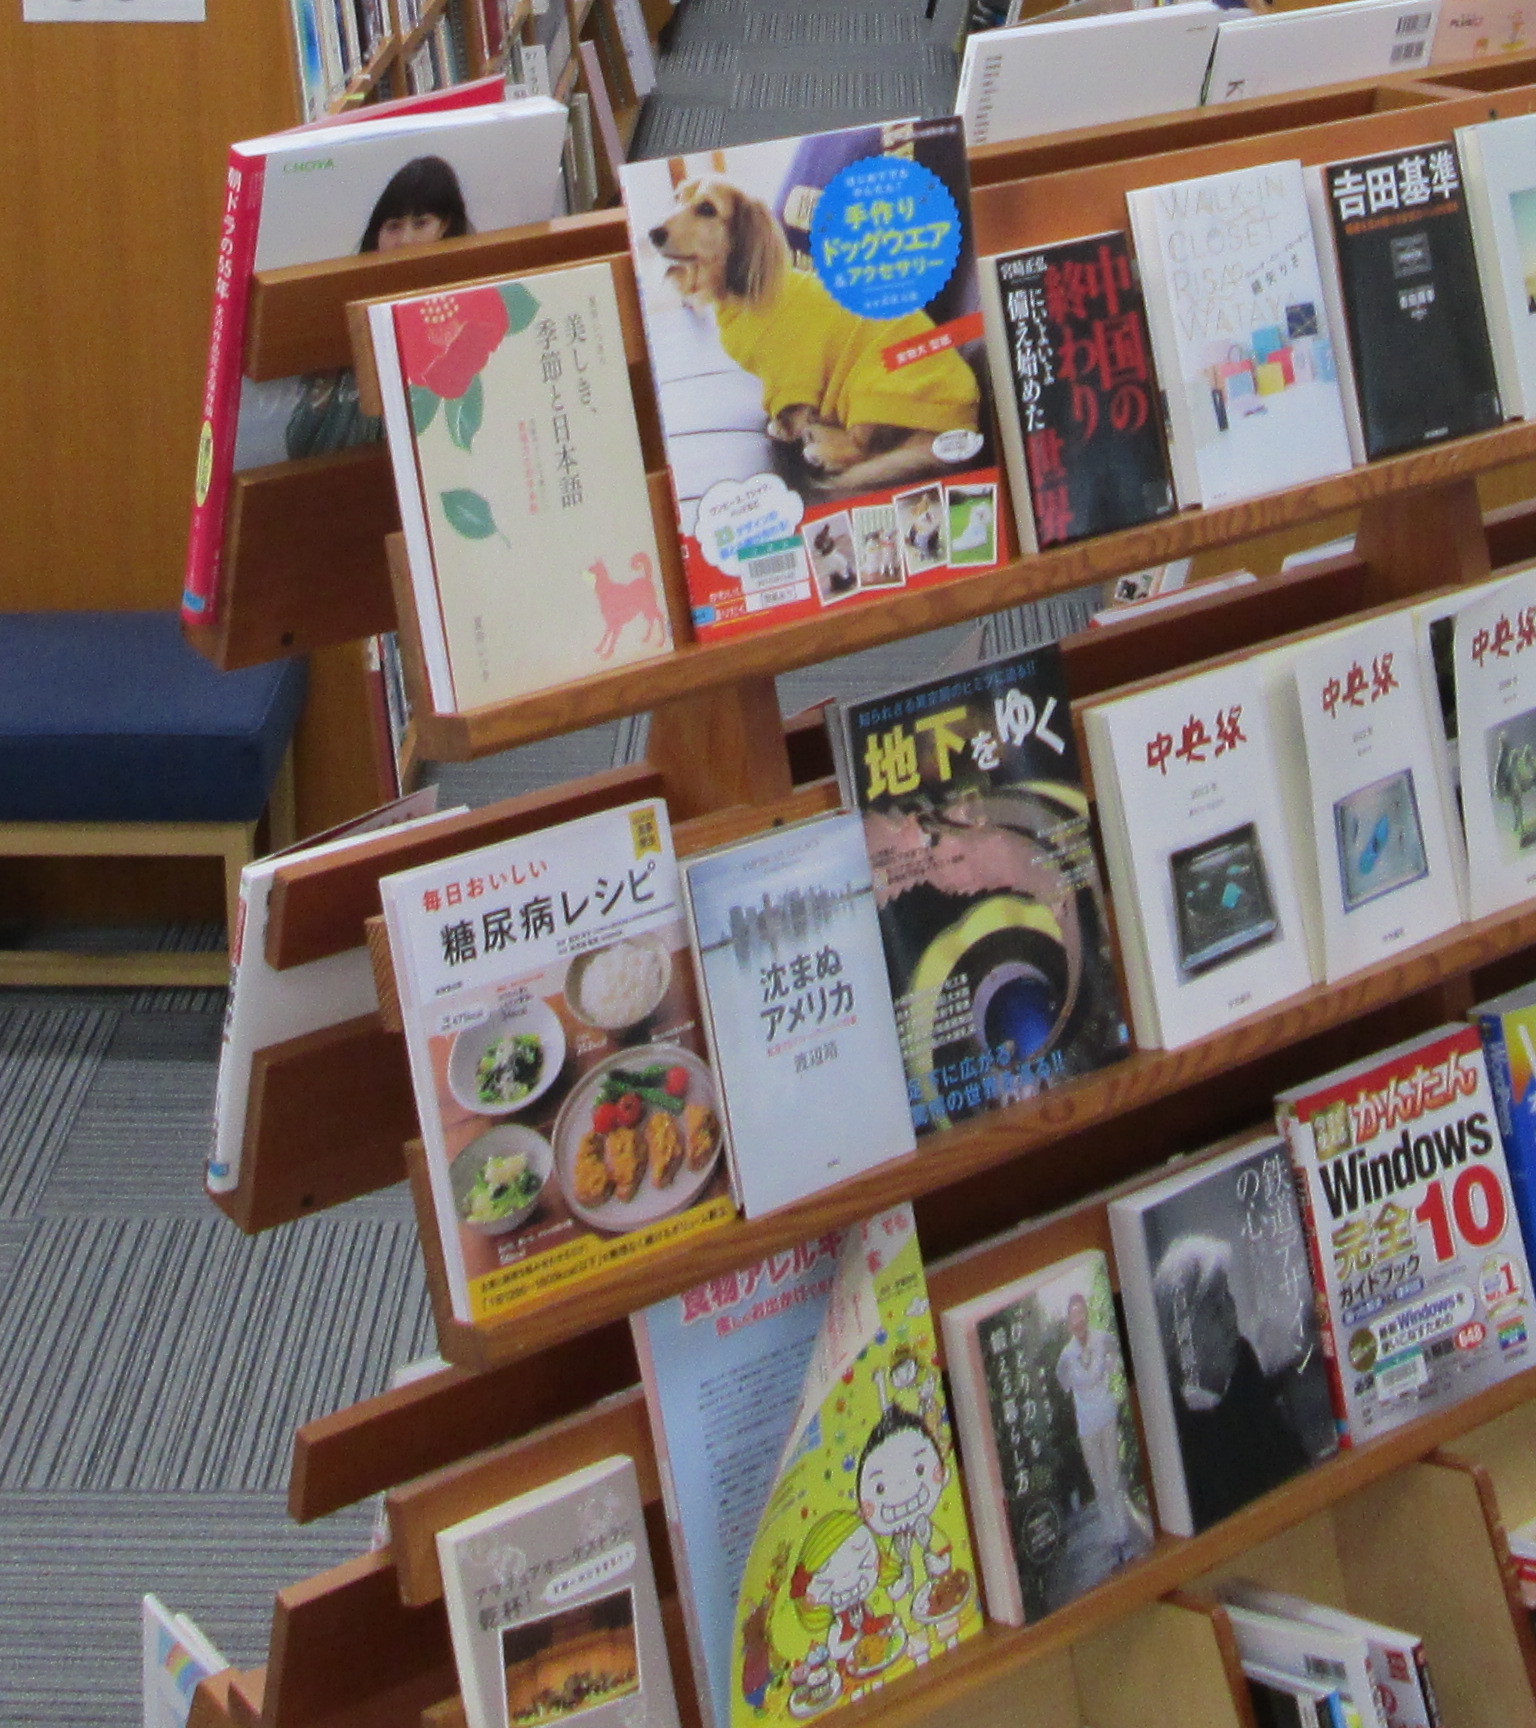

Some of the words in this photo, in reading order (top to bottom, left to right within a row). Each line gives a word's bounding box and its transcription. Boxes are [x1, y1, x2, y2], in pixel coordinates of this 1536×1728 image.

[844, 194, 915, 232] 手作り
[1332, 148, 1461, 222] 吉田基準
[823, 220, 953, 267] ドッグウエア
[846, 257, 945, 286] アクセサリー
[1166, 215, 1280, 265] CLOSET
[1007, 287, 1046, 432] 備え始めた
[1029, 287, 1055, 386] にいよいよ
[1043, 259, 1100, 445] 終わり
[1096, 244, 1150, 432] 中国の
[536, 317, 584, 510] 季節と日本語
[1027, 428, 1075, 547] 世界
[1321, 650, 1401, 719] 中央線
[865, 686, 1066, 802] 地下をゆく
[1145, 703, 1248, 775] 中央線
[421, 859, 549, 913] 毎日おいしい
[440, 859, 657, 967] 糖尿病レシピ
[760, 944, 844, 1003] 沈まぬ
[760, 981, 856, 1043] アメリカ
[1351, 1052, 1479, 1145] かんたん
[1318, 1111, 1494, 1221] Windows
[1332, 1200, 1419, 1282] 完全
[1415, 1163, 1509, 1263] 10
[1339, 1252, 1421, 1309] ガイドブック
